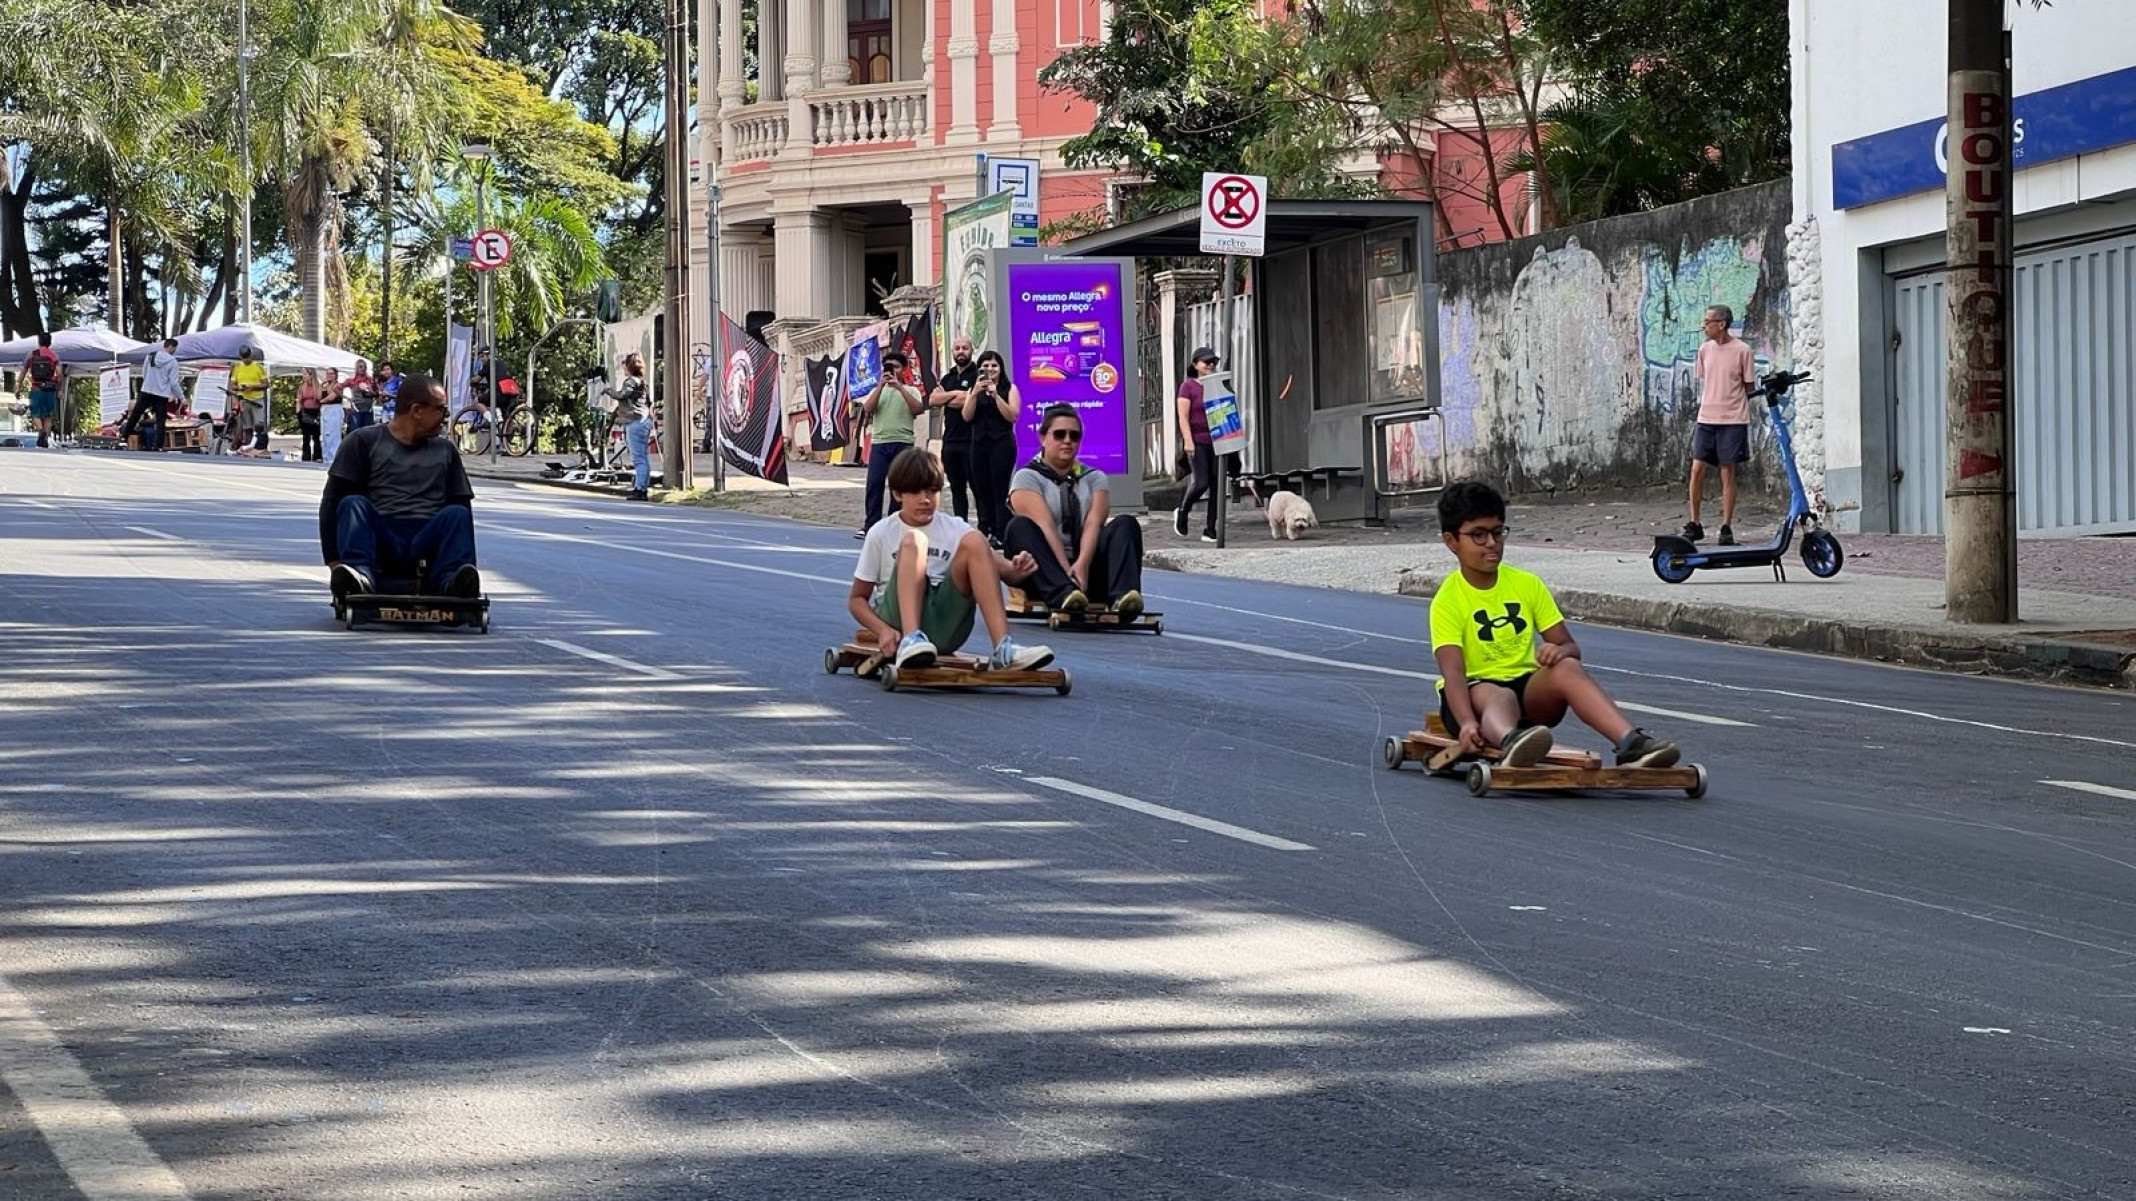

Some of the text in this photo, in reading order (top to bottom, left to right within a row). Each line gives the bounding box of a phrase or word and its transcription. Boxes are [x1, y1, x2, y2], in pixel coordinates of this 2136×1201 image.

[486, 239, 500, 260] E
[1962, 93, 2005, 415] BOUTIQUE
[1022, 291, 1031, 302] O
[1032, 293, 1067, 302] mesmo
[1037, 304, 1060, 312] novo
[380, 608, 454, 621] BATMAN
